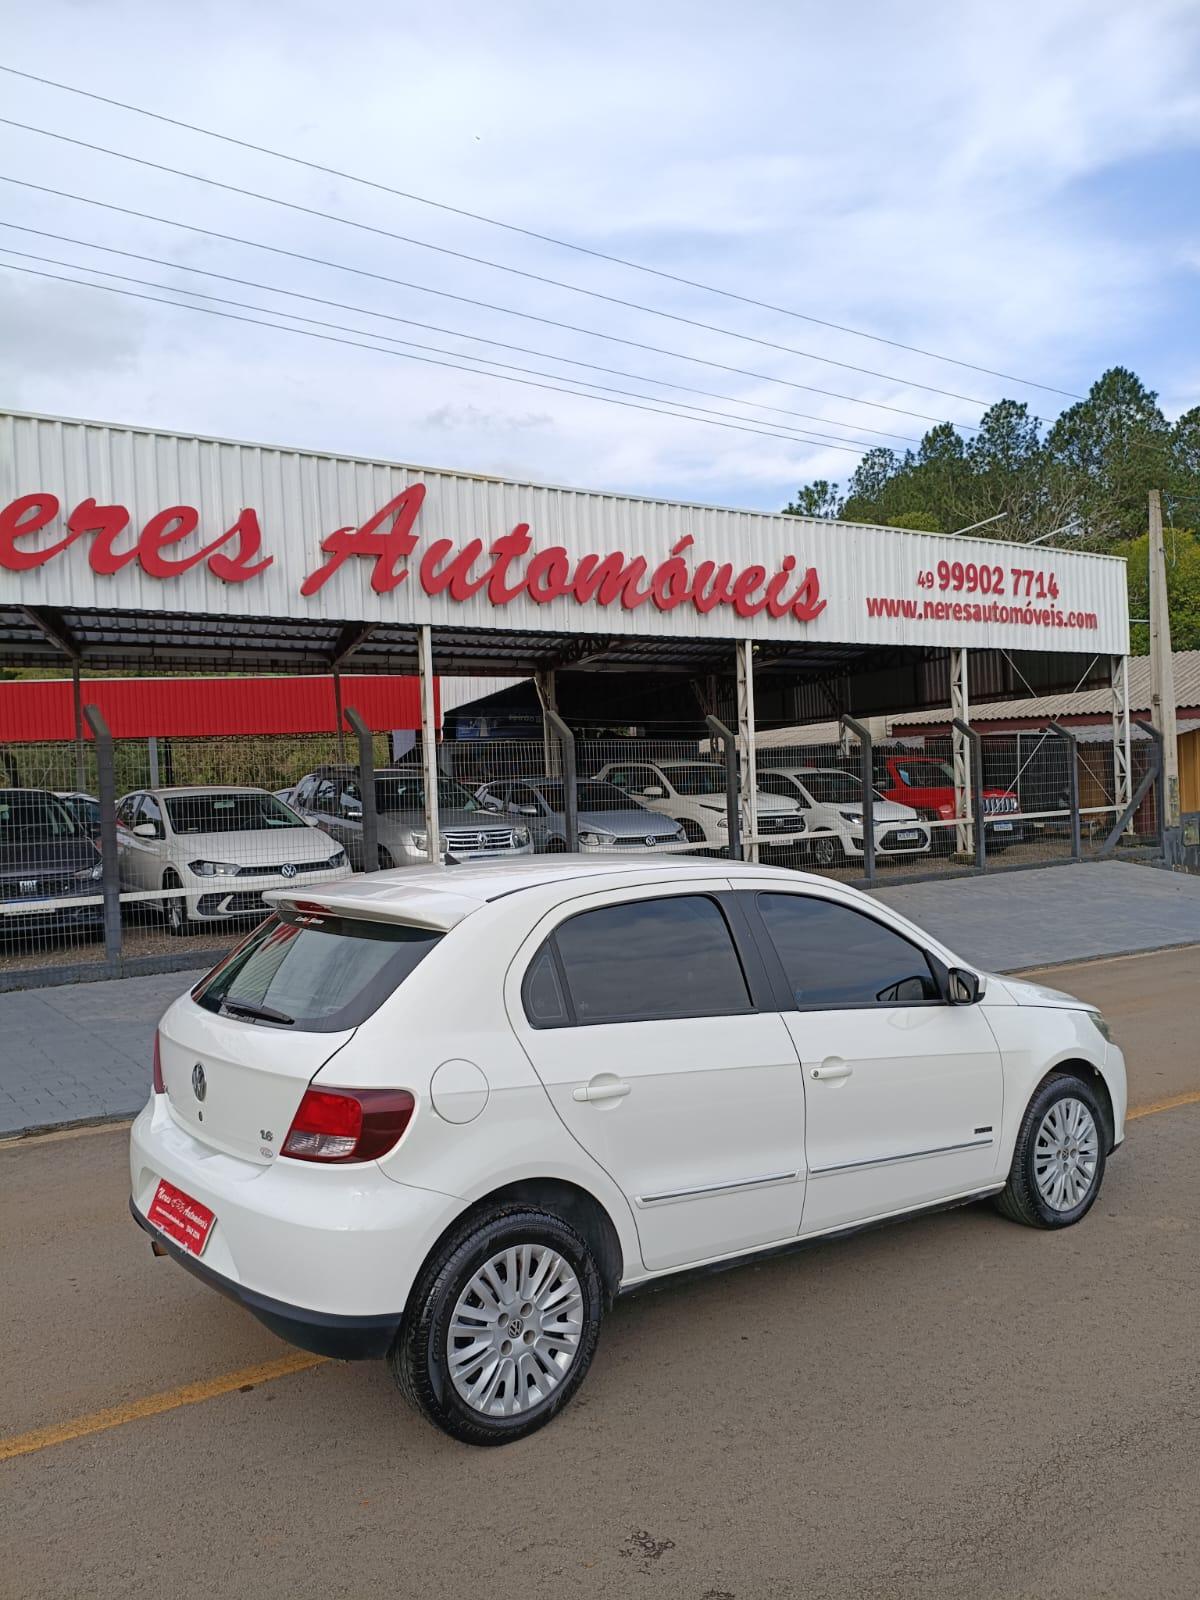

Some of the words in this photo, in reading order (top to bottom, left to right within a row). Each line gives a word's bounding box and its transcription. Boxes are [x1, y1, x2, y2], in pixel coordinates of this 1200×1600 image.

[300, 483, 827, 621] Automóveis
[917, 570, 935, 589] 49
[937, 560, 1005, 595] 99902
[1010, 568, 1060, 600] 7714
[866, 597, 1098, 630] www.neresautomóveis.com
